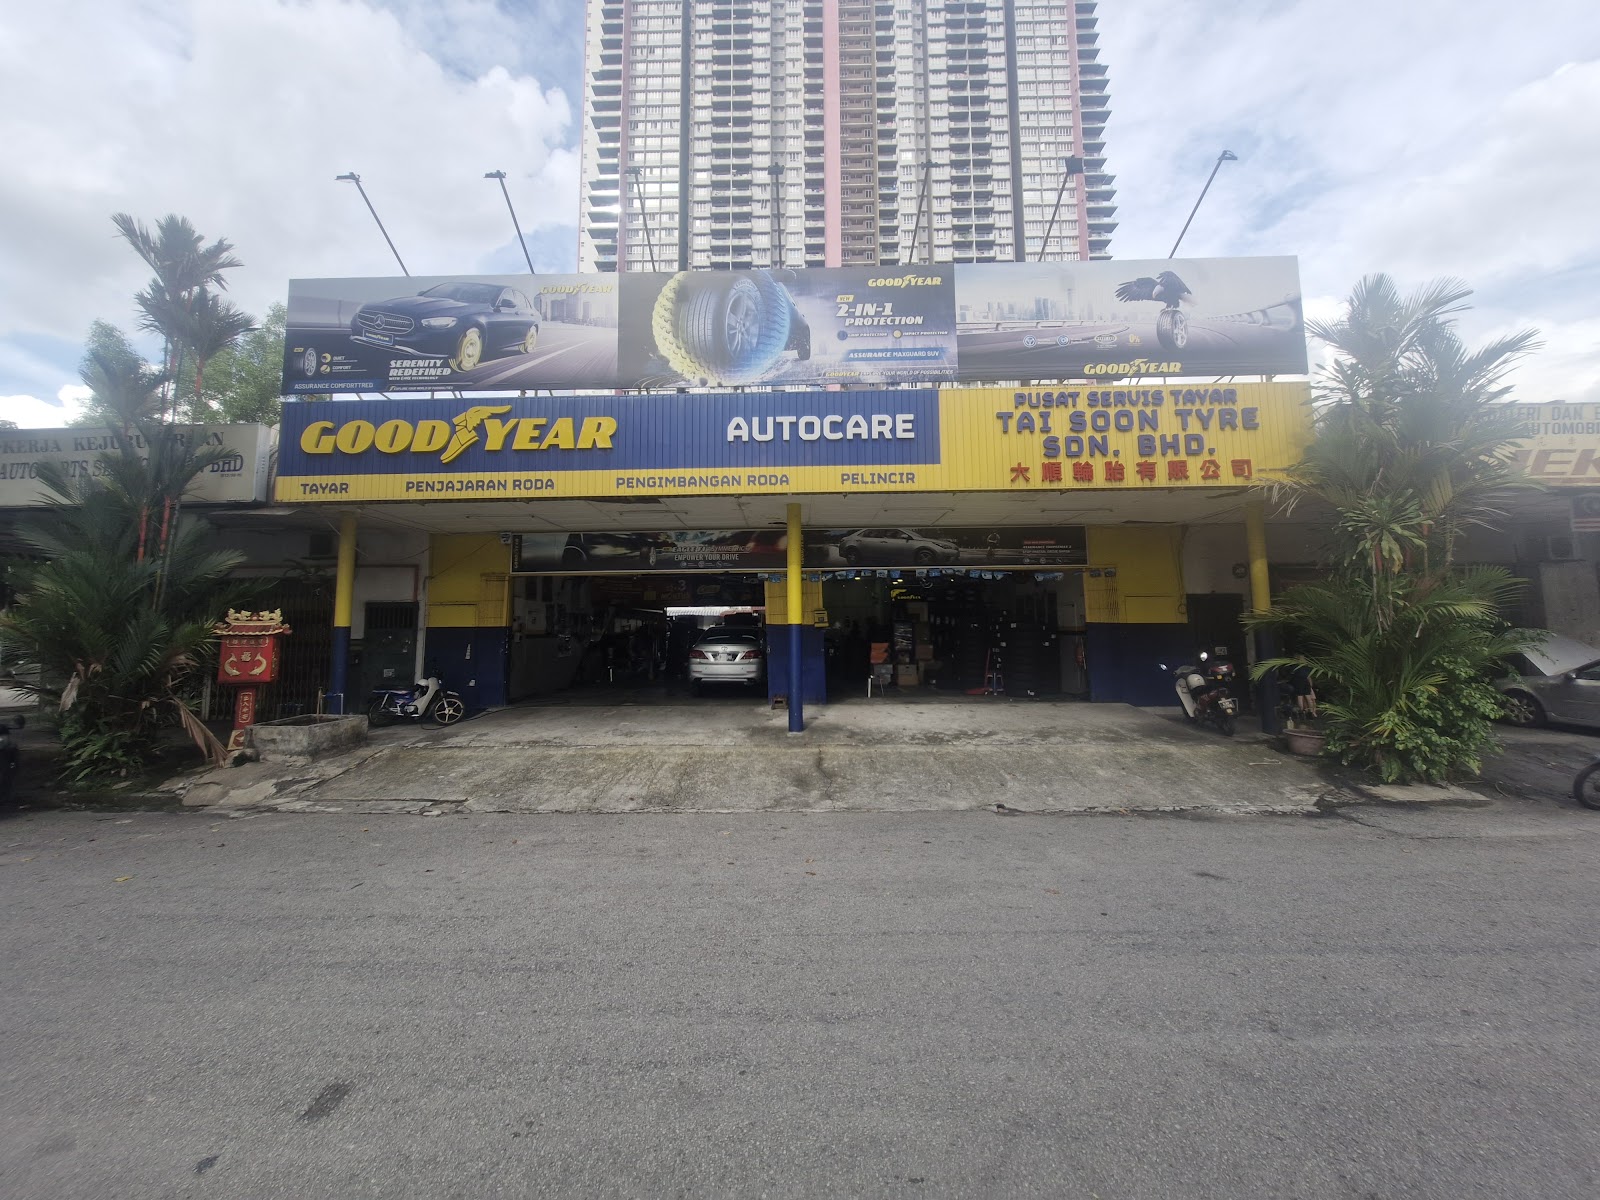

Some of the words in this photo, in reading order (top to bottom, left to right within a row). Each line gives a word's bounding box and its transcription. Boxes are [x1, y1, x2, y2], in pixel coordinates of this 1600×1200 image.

[540, 283, 613, 295] GOODYEAR
[868, 276, 942, 288] GOODYEAR
[836, 302, 893, 317] 2-IN-1
[845, 315, 924, 326] PROTECTION
[389, 359, 443, 368] SERENITY
[1083, 361, 1182, 375] GOODYEAR
[389, 367, 451, 377] REDEFINED
[1013, 391, 1081, 409] PUSAT
[1086, 389, 1164, 407] SERVIS
[1169, 388, 1237, 405] TAYAR
[996, 411, 1052, 433] TAI
[1069, 409, 1159, 432] SOON
[1175, 406, 1260, 430] TYRE
[1551, 406, 1583, 421] DAN
[300, 415, 617, 455] GOODYEAR
[727, 413, 915, 443] AUTOCARE
[1043, 434, 1120, 458] SDN.
[1137, 433, 1216, 457] BHD.
[1010, 458, 1253, 483] 大順輪胎有限公司
[405, 479, 508, 493] PENJAJARAN
[512, 478, 555, 491] RODA
[616, 475, 742, 489] PENGIMBANGAN
[747, 474, 789, 487] RODA
[841, 472, 915, 485] PELINCIR
[301, 482, 349, 495] TAYAR
